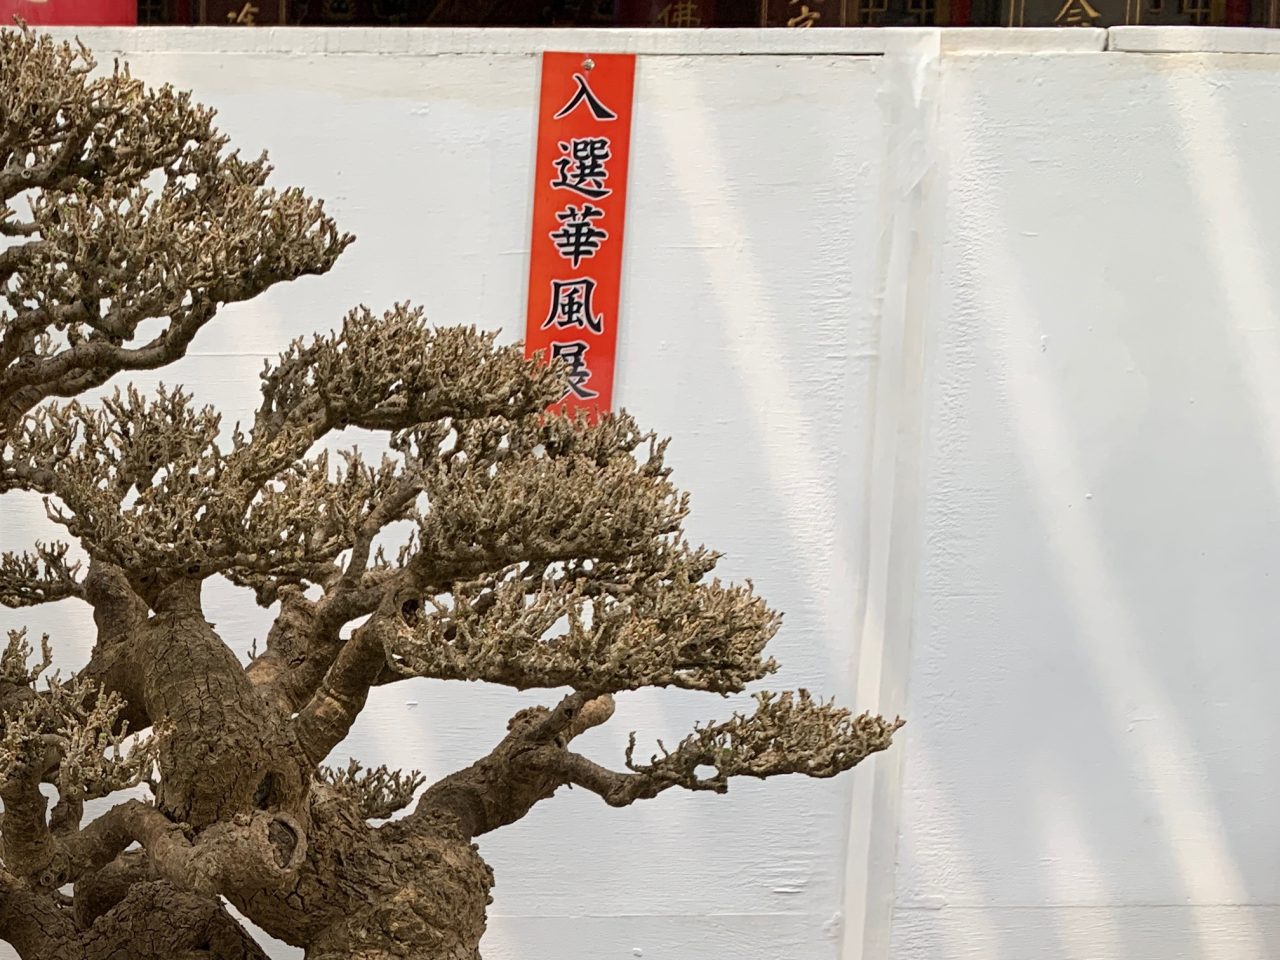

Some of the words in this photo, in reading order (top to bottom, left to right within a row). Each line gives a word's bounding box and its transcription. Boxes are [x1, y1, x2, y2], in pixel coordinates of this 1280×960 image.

[541, 73, 618, 400] 入選華風展
